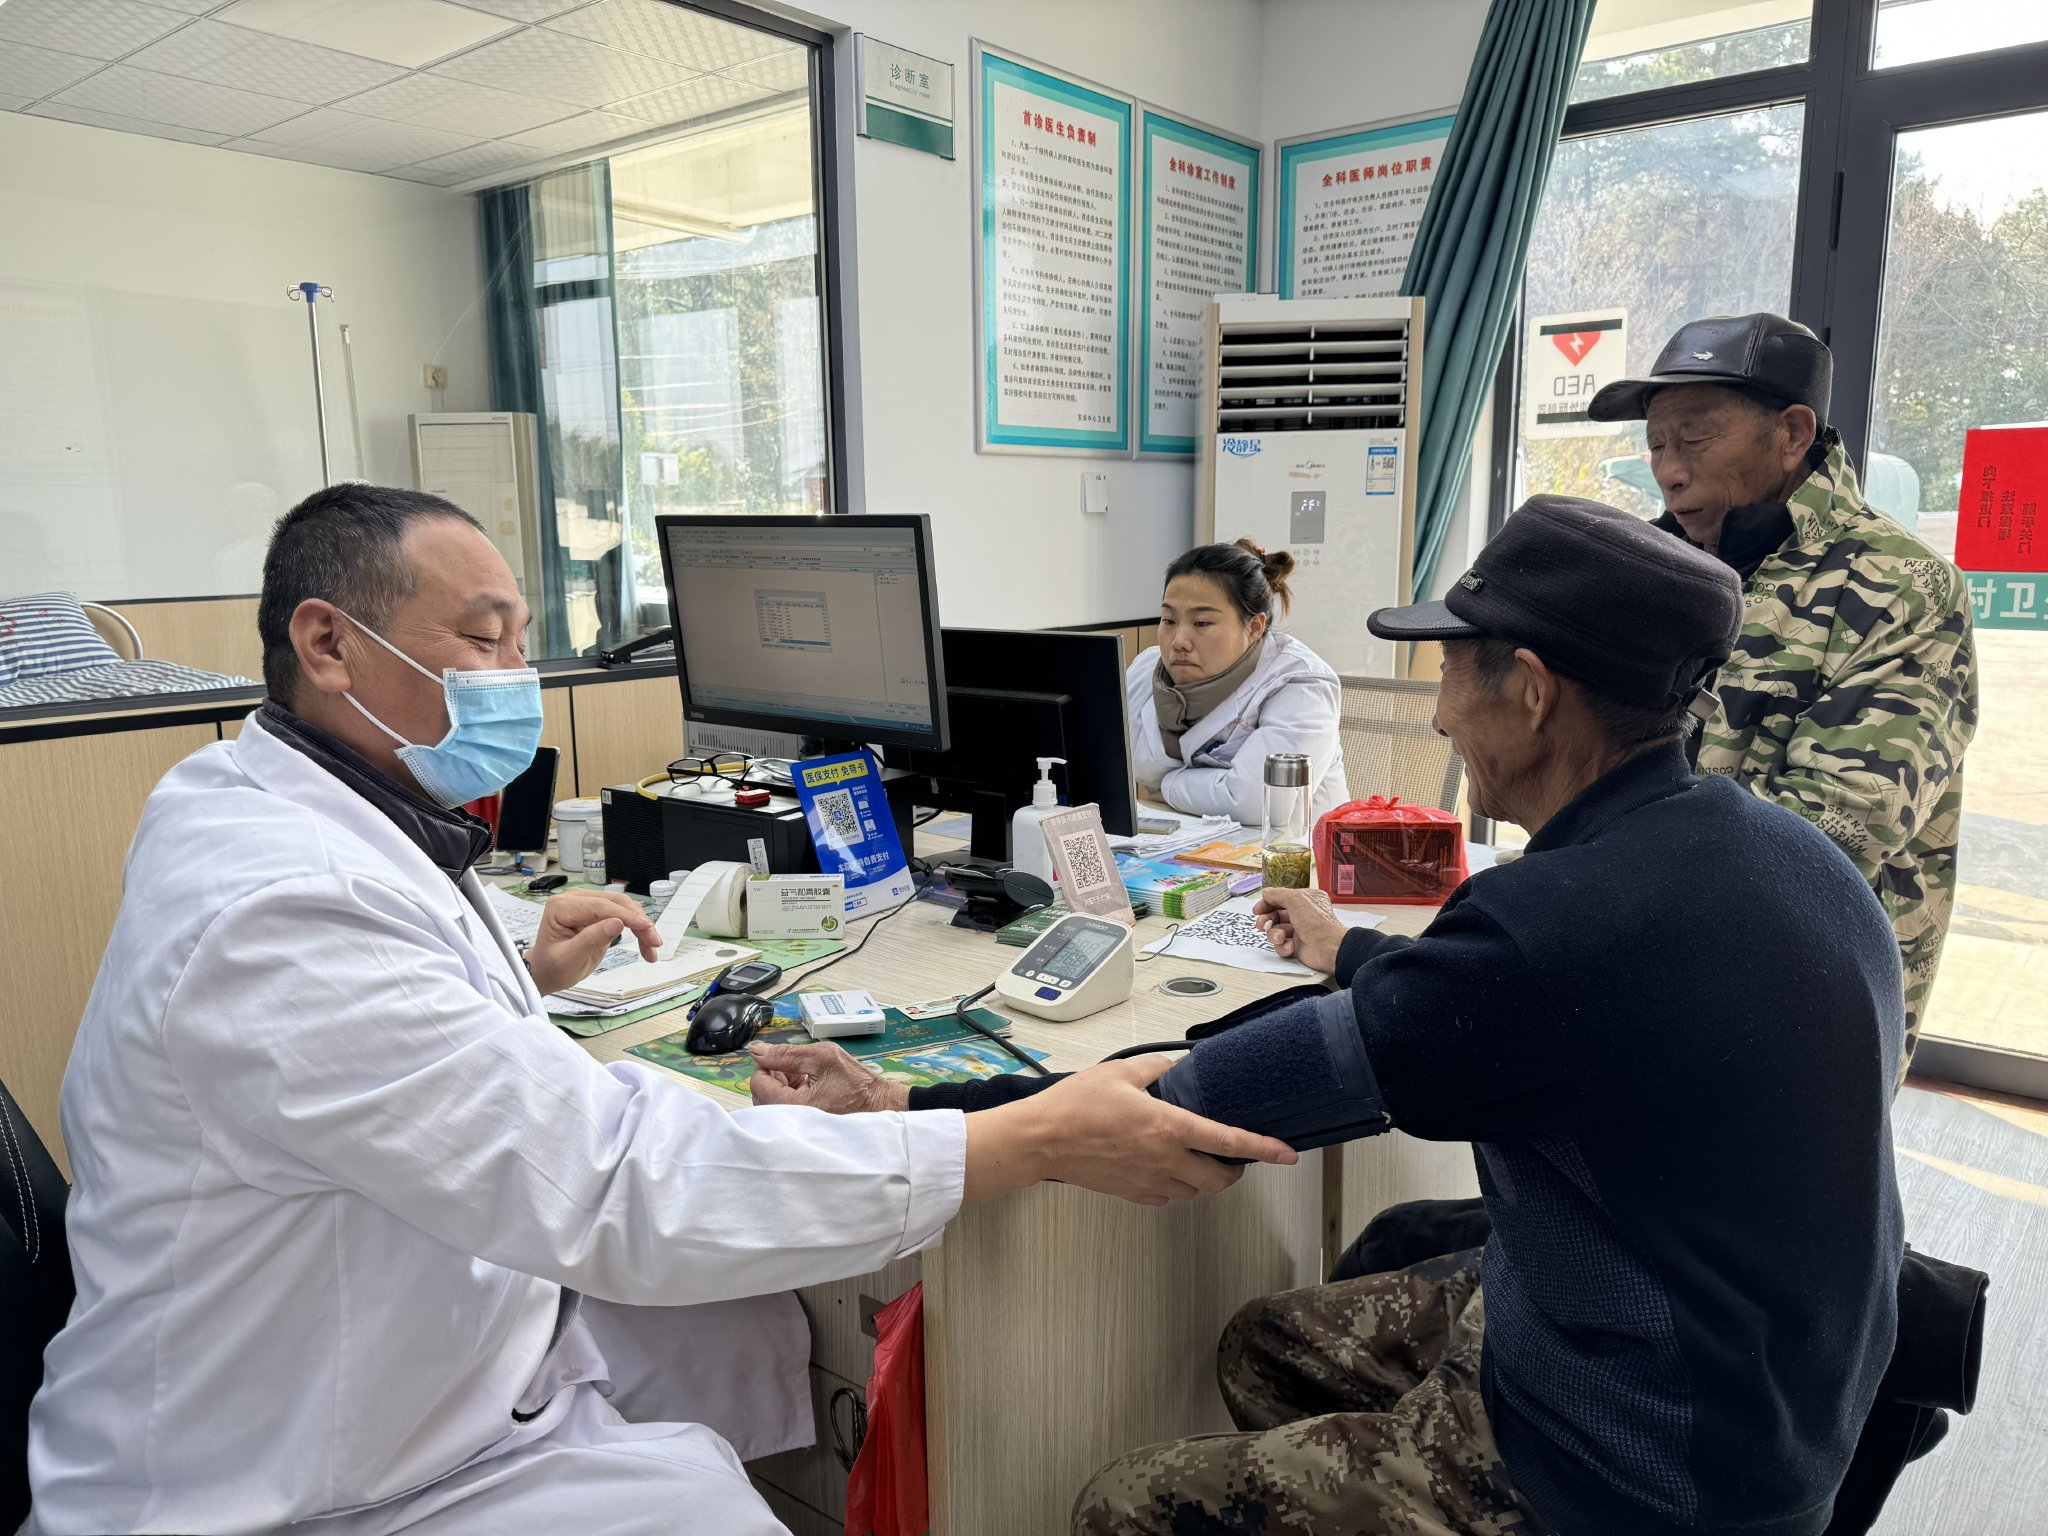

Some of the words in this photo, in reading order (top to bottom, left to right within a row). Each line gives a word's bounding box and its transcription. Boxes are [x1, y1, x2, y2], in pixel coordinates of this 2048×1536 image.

[890, 63, 930, 89] 诊断室
[1023, 109, 1097, 149] 首诊医生负责制
[1322, 157, 1432, 187] 全科医师岗位职责
[1223, 438, 1263, 453] 冷静星
[1966, 578, 2048, 620] 村卫
[805, 769, 840, 784] 医保支付
[840, 763, 867, 777] 免带卡
